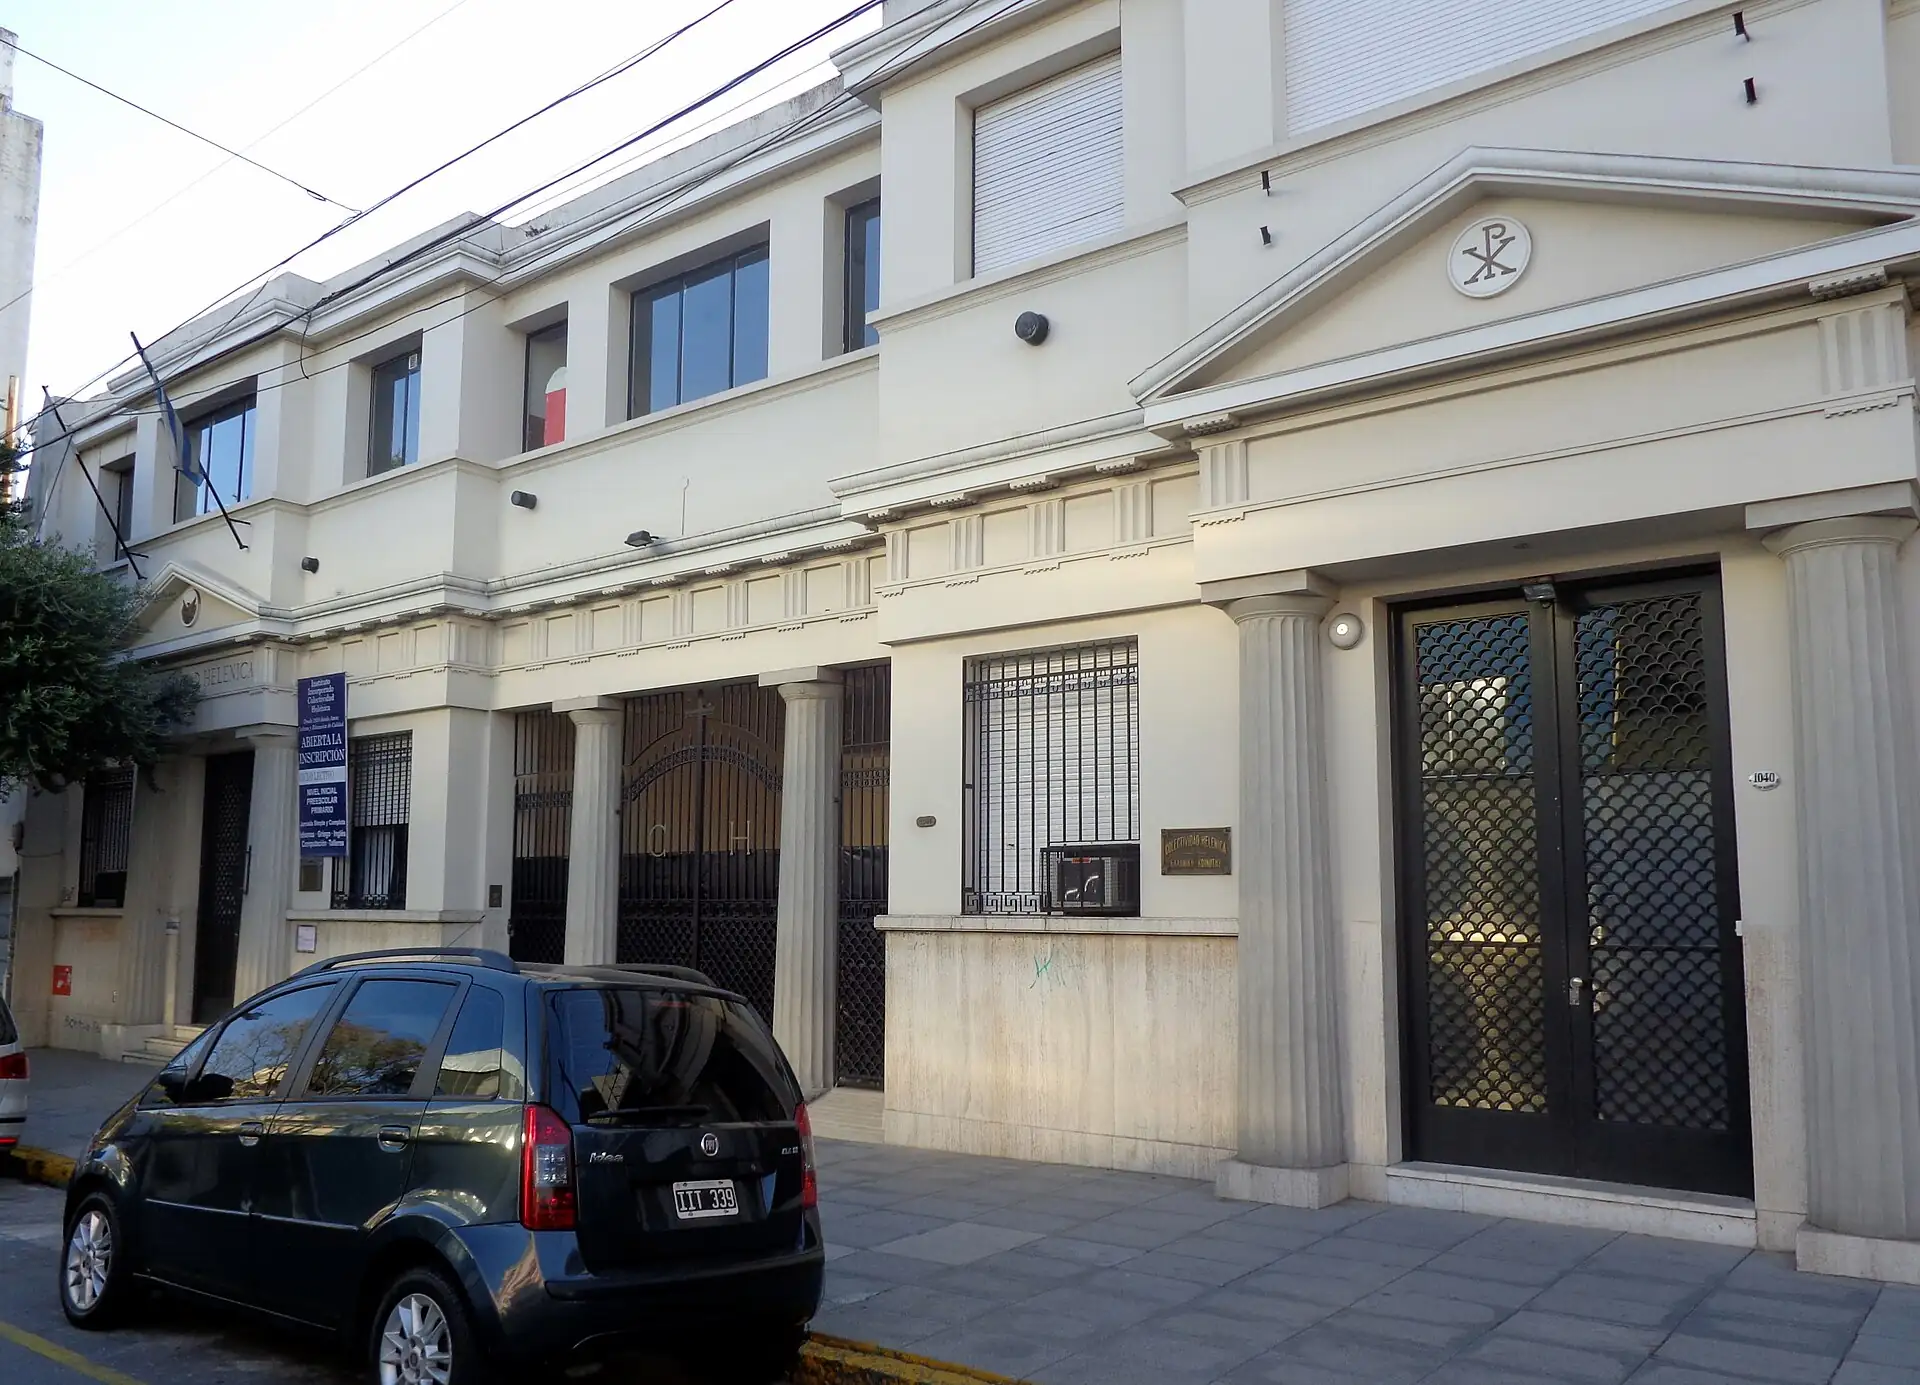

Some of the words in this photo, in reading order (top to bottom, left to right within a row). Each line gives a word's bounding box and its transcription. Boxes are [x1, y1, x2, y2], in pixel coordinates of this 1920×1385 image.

[301, 734, 332, 749] ABIERTA
[332, 732, 342, 745] LA
[299, 748, 345, 764] INSCRIPCIÓN
[1754, 773, 1775, 783] 1040
[307, 788, 320, 796] NIVEL
[321, 787, 338, 795] INICIAL
[307, 796, 338, 805] PREESCOLAR
[729, 820, 751, 856] H
[676, 1191, 702, 1212] IIT
[711, 1187, 736, 1208] 339
